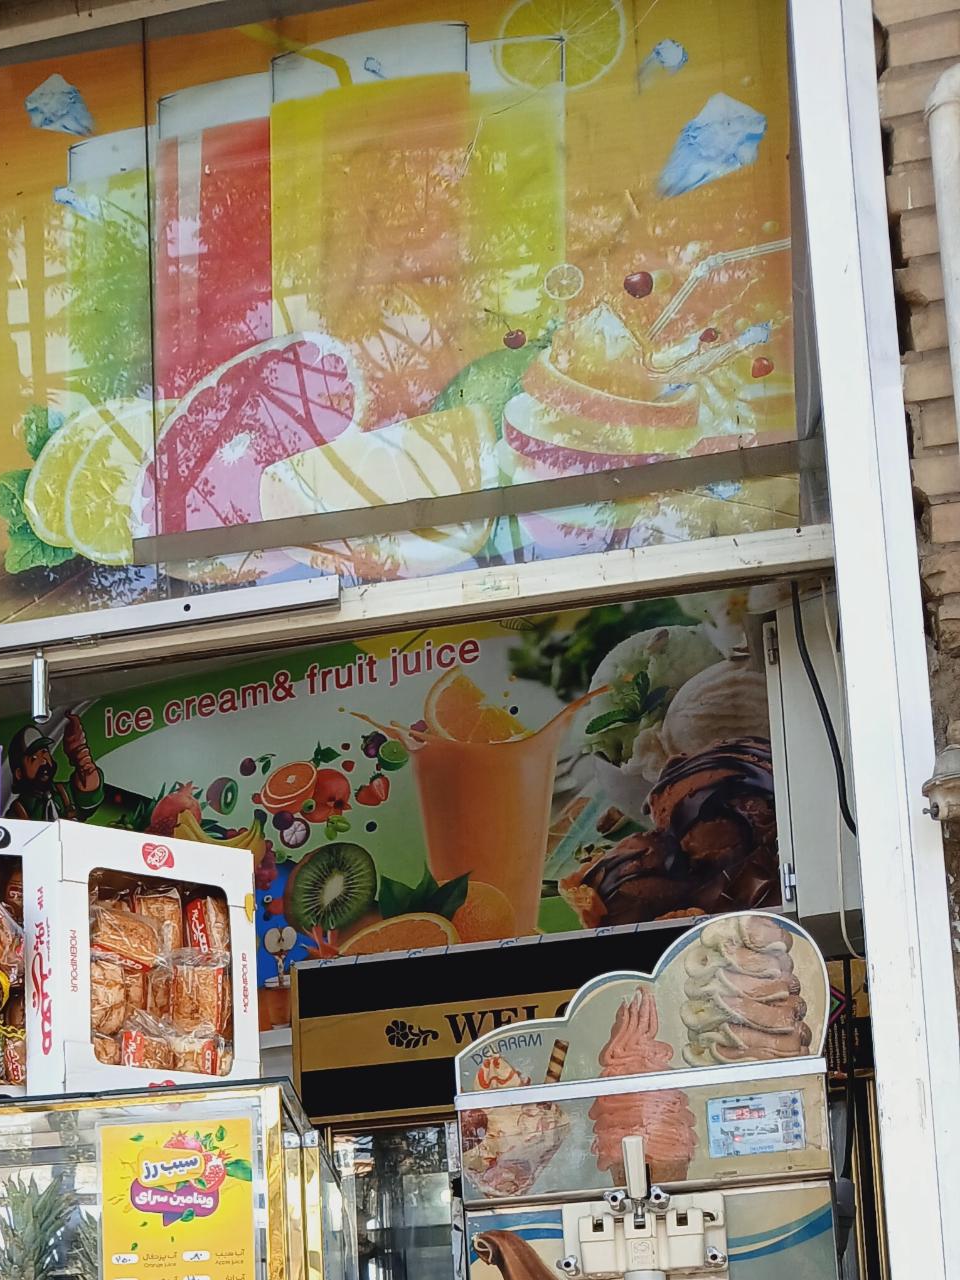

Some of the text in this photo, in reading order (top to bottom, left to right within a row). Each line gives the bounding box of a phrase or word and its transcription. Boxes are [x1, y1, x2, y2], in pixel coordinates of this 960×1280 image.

[104, 638, 481, 738] ice cream& fruit juice
[471, 1033, 543, 1066] DELARAM
[142, 1156, 199, 1180] سیب رز
[134, 1191, 215, 1209] ویتامین سرای
